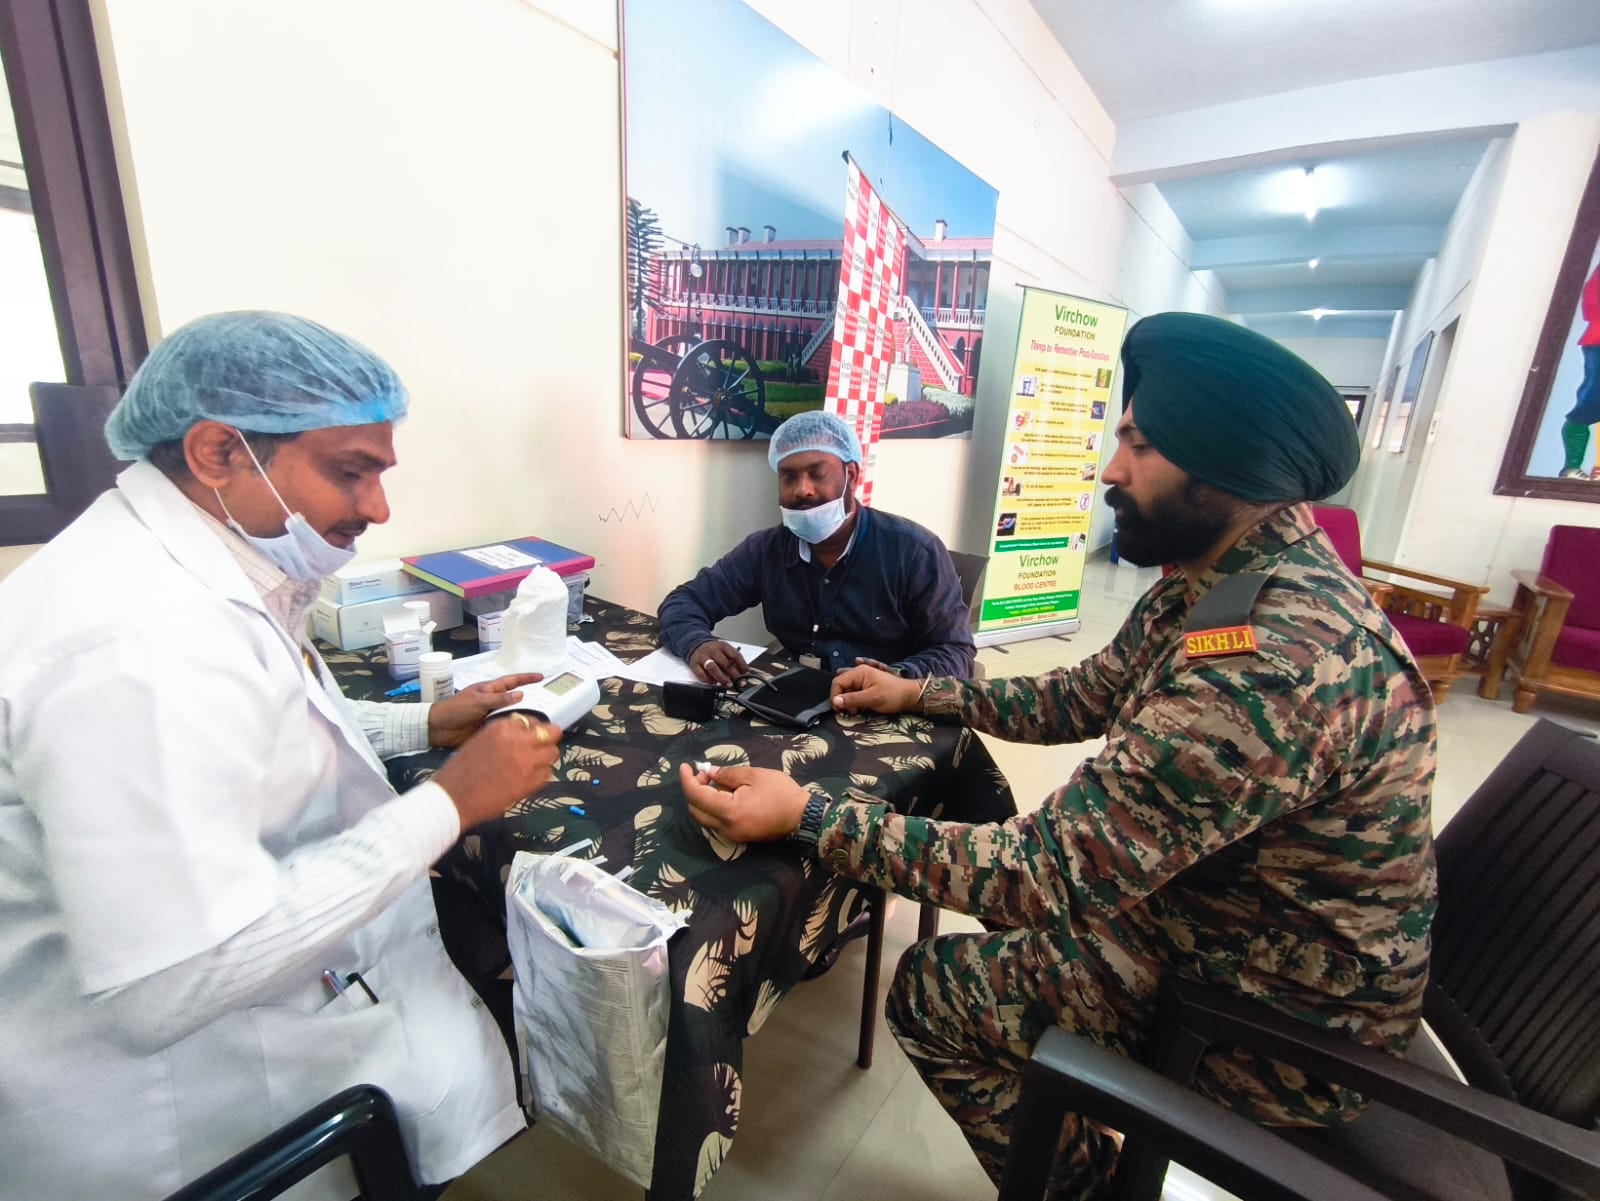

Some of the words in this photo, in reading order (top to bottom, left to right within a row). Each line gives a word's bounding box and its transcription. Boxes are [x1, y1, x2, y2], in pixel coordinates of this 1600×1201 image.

[1055, 304, 1098, 327] Virchow
[1054, 326, 1096, 341] FOUNDATION
[1019, 554, 1059, 568] Virchow
[1018, 569, 1057, 580] FOUNDATION
[1014, 583, 1034, 592] BLOOD
[1035, 580, 1057, 590] CENTRE
[1186, 632, 1230, 654] SIKH
[1231, 630, 1253, 649] LI
